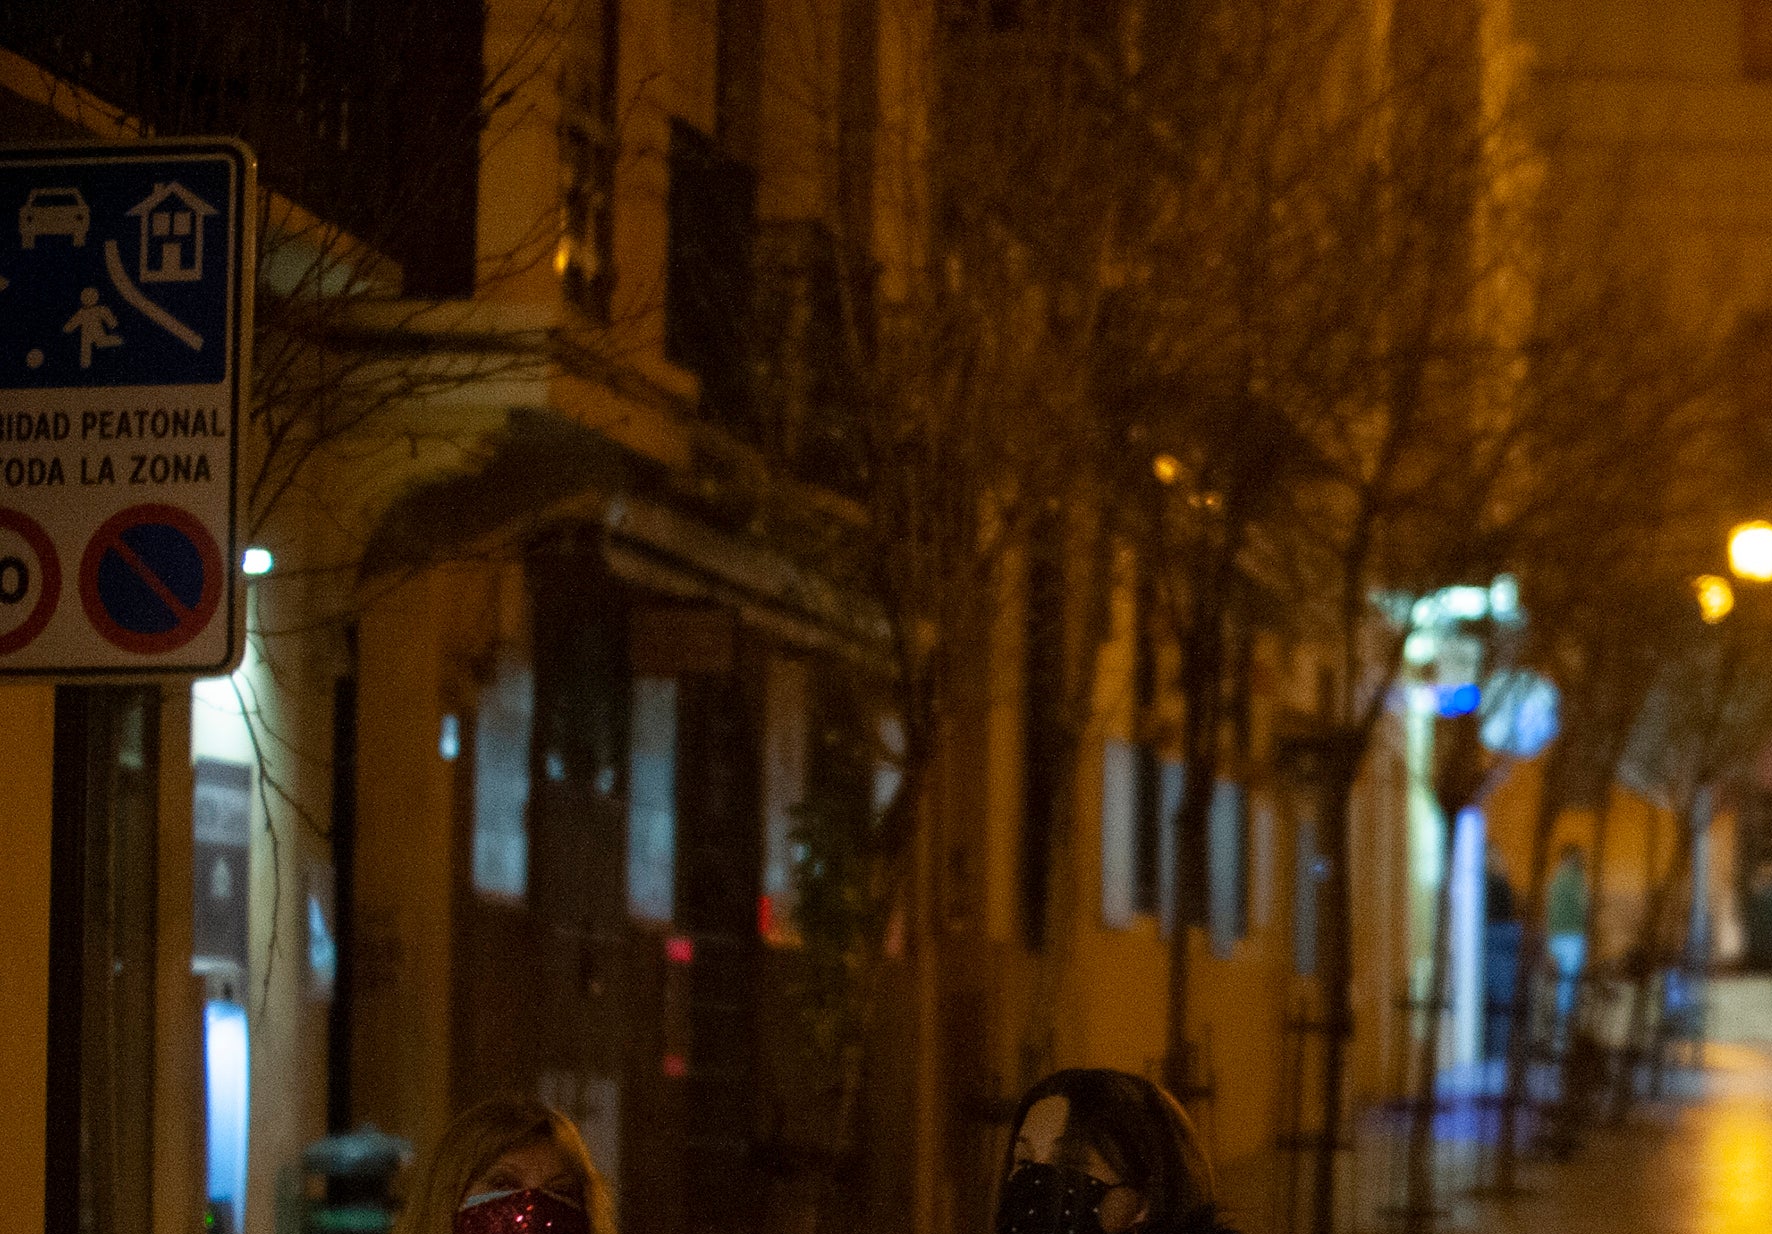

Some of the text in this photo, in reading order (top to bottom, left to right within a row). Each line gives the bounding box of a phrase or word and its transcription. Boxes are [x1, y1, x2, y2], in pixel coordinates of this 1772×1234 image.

[81, 409, 226, 439] PEATONAL
[0, 454, 211, 487] ODA LA ZONA
